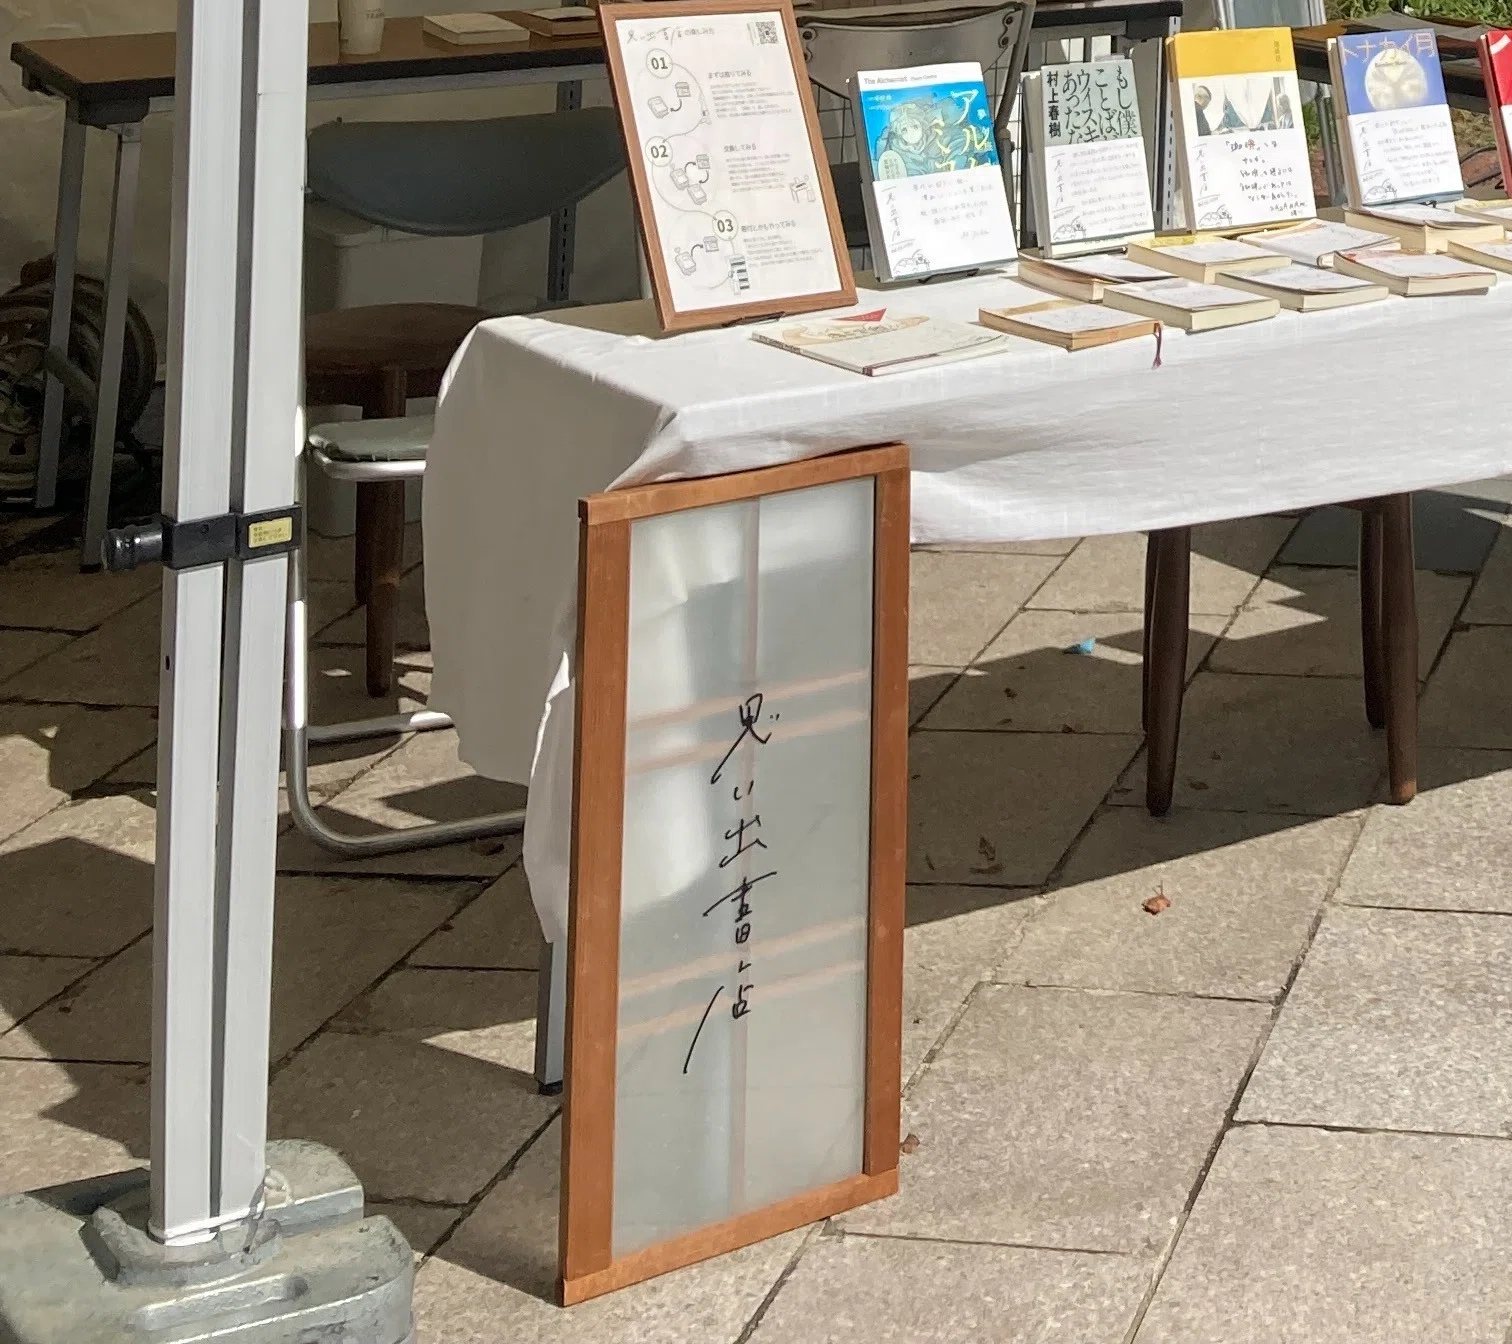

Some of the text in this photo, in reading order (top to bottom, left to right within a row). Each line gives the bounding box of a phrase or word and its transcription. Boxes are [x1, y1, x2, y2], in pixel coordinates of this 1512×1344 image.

[651, 57, 668, 70] 01
[1047, 71, 1062, 138] 村上春樹
[1095, 68, 1119, 140] ことば
[1117, 65, 1138, 138] もし僕
[650, 145, 669, 159] 02
[717, 218, 734, 233] 03
[681, 692, 779, 1075] 思い出書店
